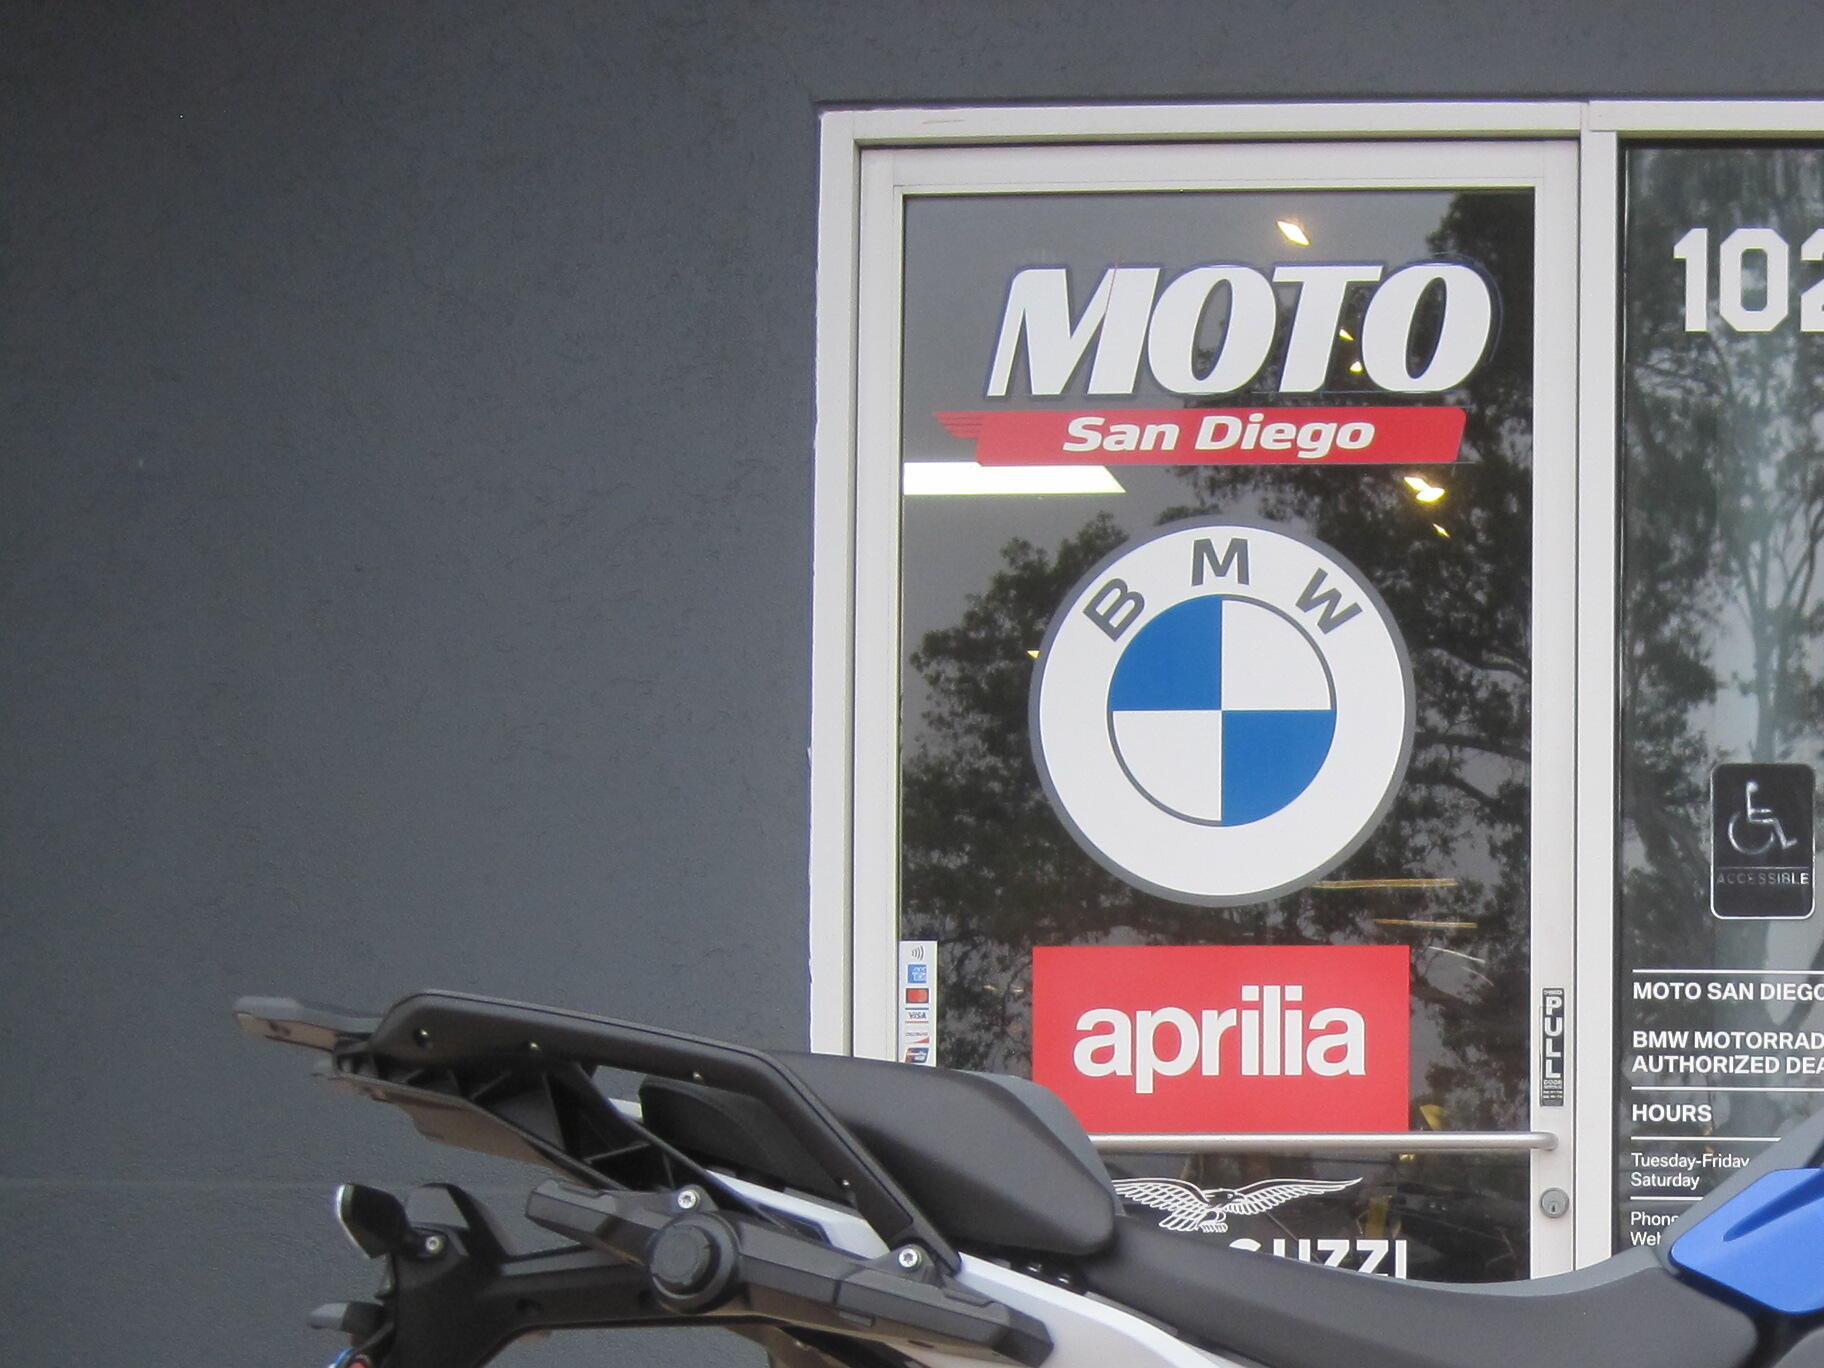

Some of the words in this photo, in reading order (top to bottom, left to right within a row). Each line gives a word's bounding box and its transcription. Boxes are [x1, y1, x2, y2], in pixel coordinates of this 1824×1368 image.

[986, 263, 1493, 396] MOTO
[1062, 416, 1177, 452] San
[1195, 414, 1375, 459] Diego
[1082, 537, 1363, 642] BMW
[1716, 872, 1809, 885] ACCESSIBLE
[1633, 982, 1700, 1000] MOTO
[1707, 983, 1754, 1000] SAN
[1073, 985, 1367, 1093] aprilia
[1544, 996, 1562, 1079] PULL
[1633, 1031, 1688, 1049] BMW
[1631, 1055, 1780, 1074] AUTHORIZED
[1632, 1104, 1712, 1122] HOURS
[1631, 1153, 1750, 1171] Tuesday-Friday
[1631, 1172, 1700, 1190] Saturday
[1229, 1238, 1408, 1280] ZZI
